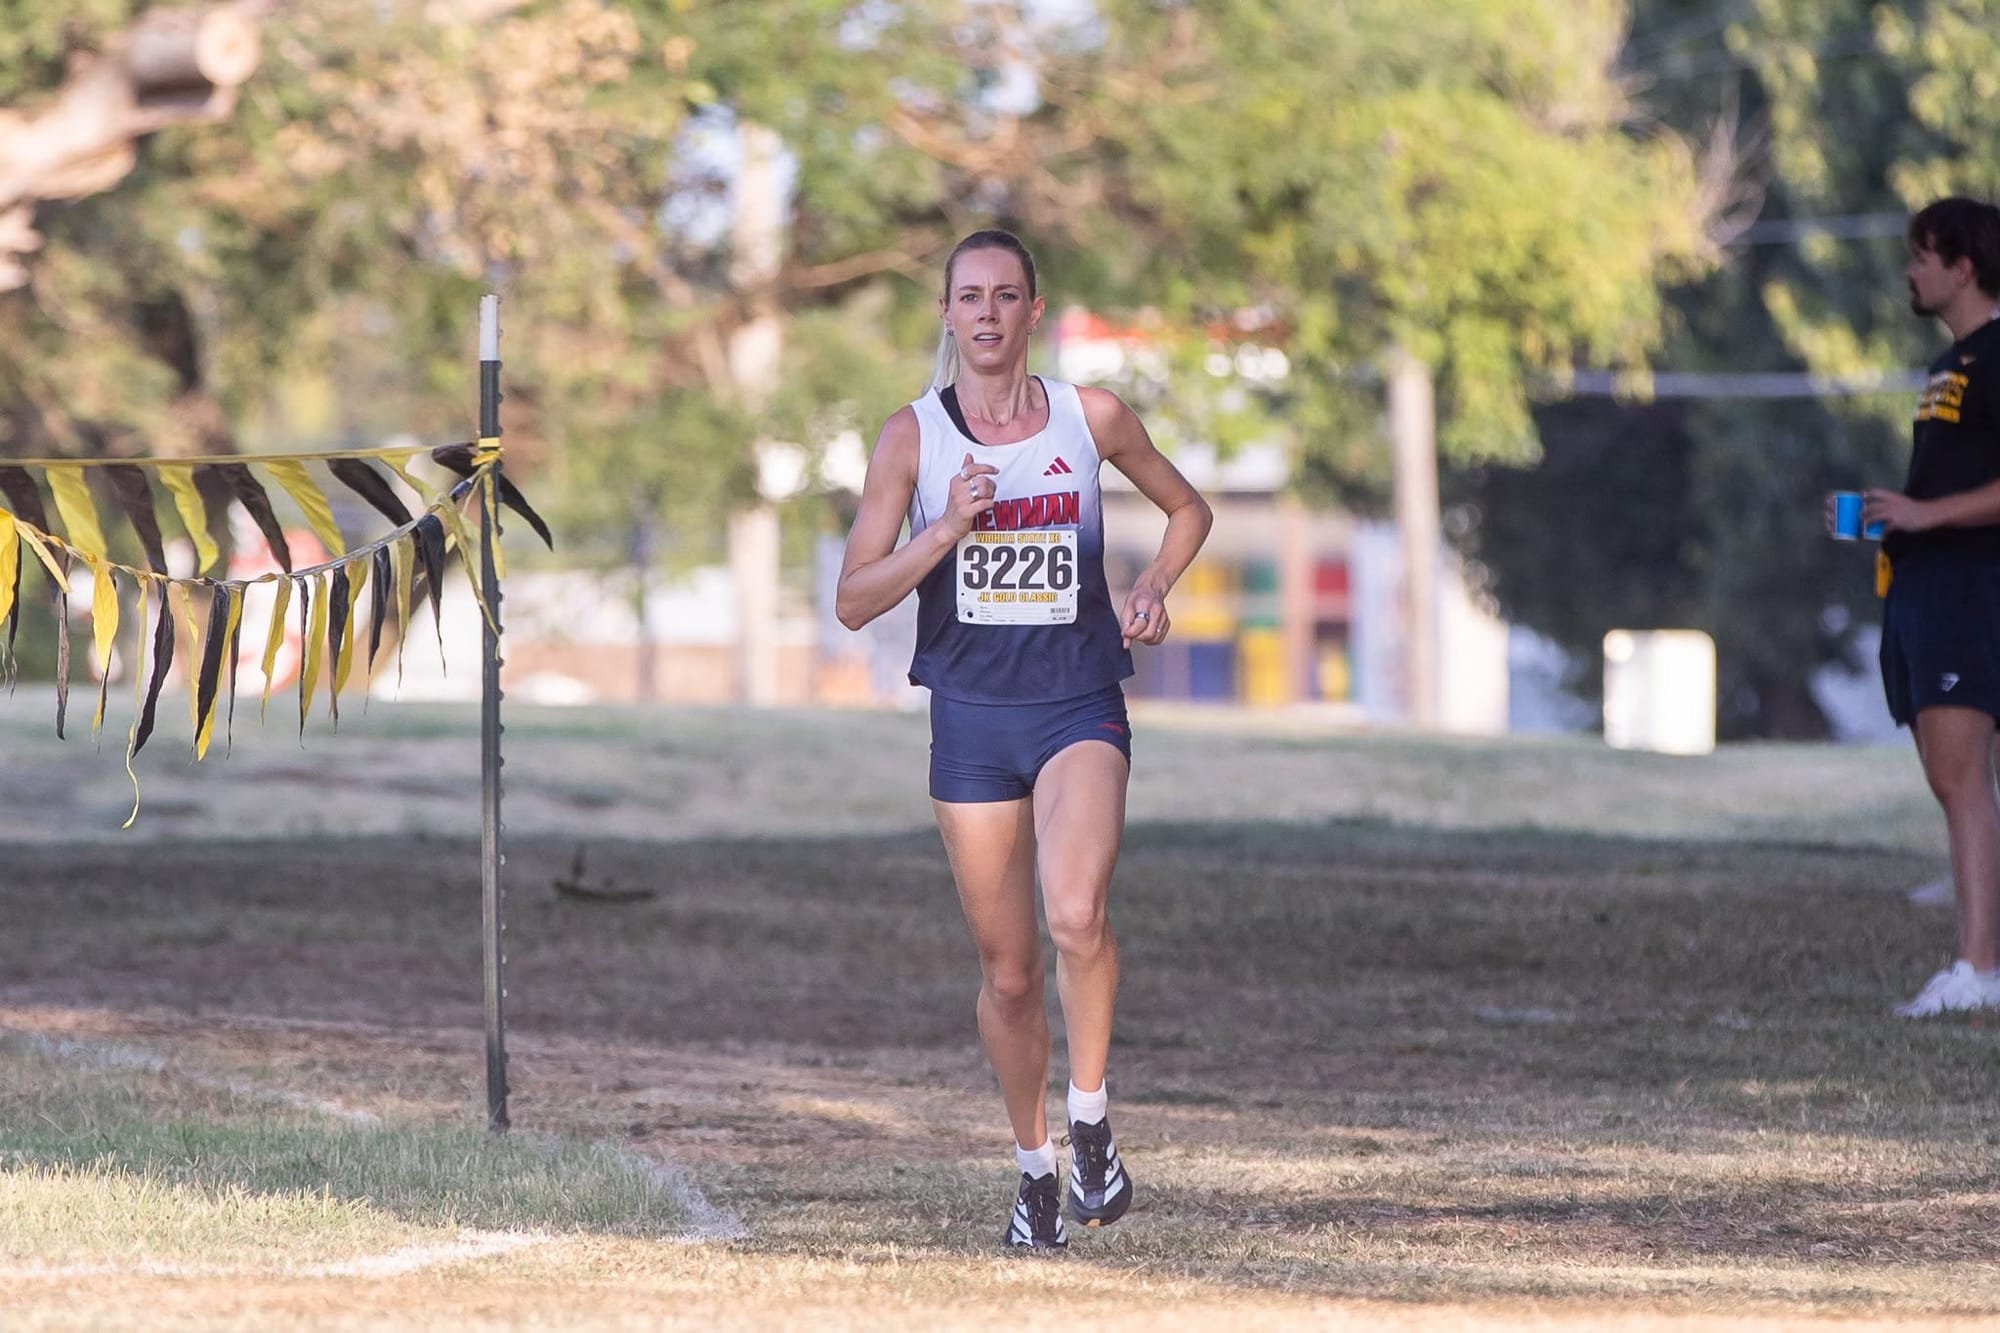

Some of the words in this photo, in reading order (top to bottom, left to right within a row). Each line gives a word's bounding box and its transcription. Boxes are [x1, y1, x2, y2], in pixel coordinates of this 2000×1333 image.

[1017, 533, 1047, 544] STATE
[963, 545, 1073, 590] 3226
[978, 592, 990, 603] JK
[992, 592, 1017, 603] GOLD
[1019, 592, 1057, 603] CLASSIC
